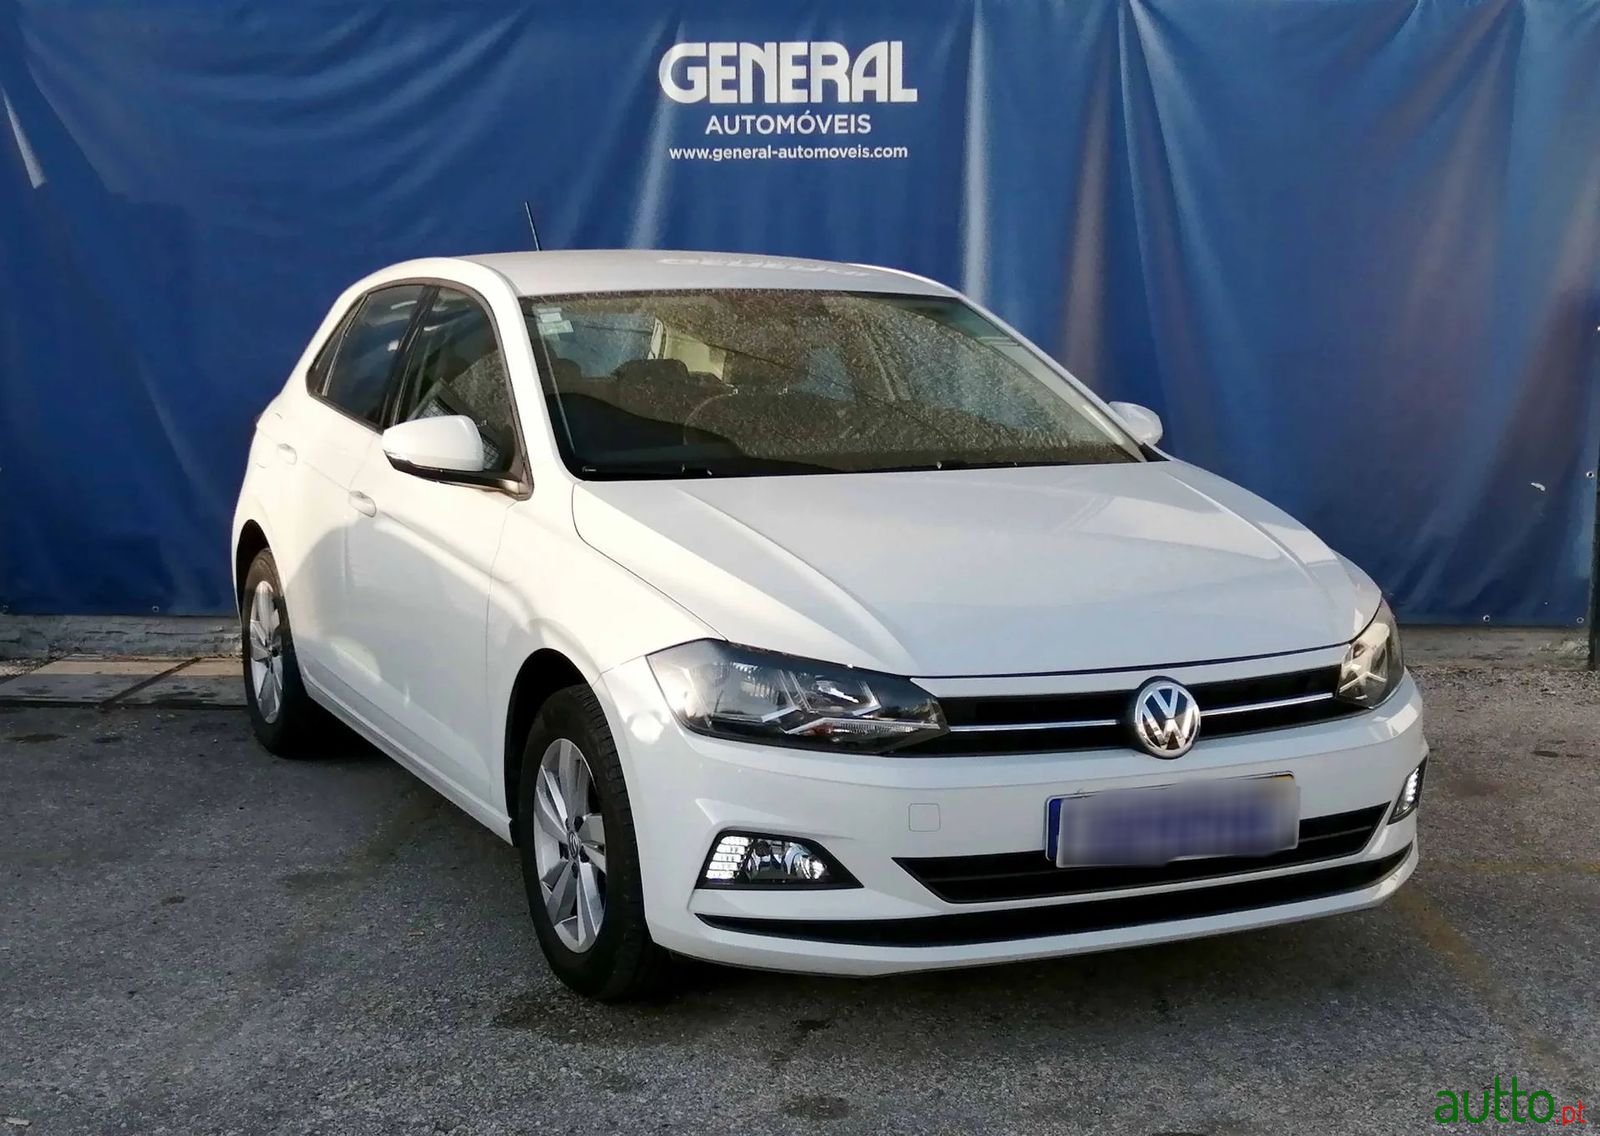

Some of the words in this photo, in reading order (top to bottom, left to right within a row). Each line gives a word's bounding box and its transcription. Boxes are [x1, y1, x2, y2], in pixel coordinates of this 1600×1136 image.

[658, 41, 918, 104] GENERAL
[705, 110, 872, 135] AUTOMÓVEIS
[669, 145, 909, 161] www.general-automoveis.com
